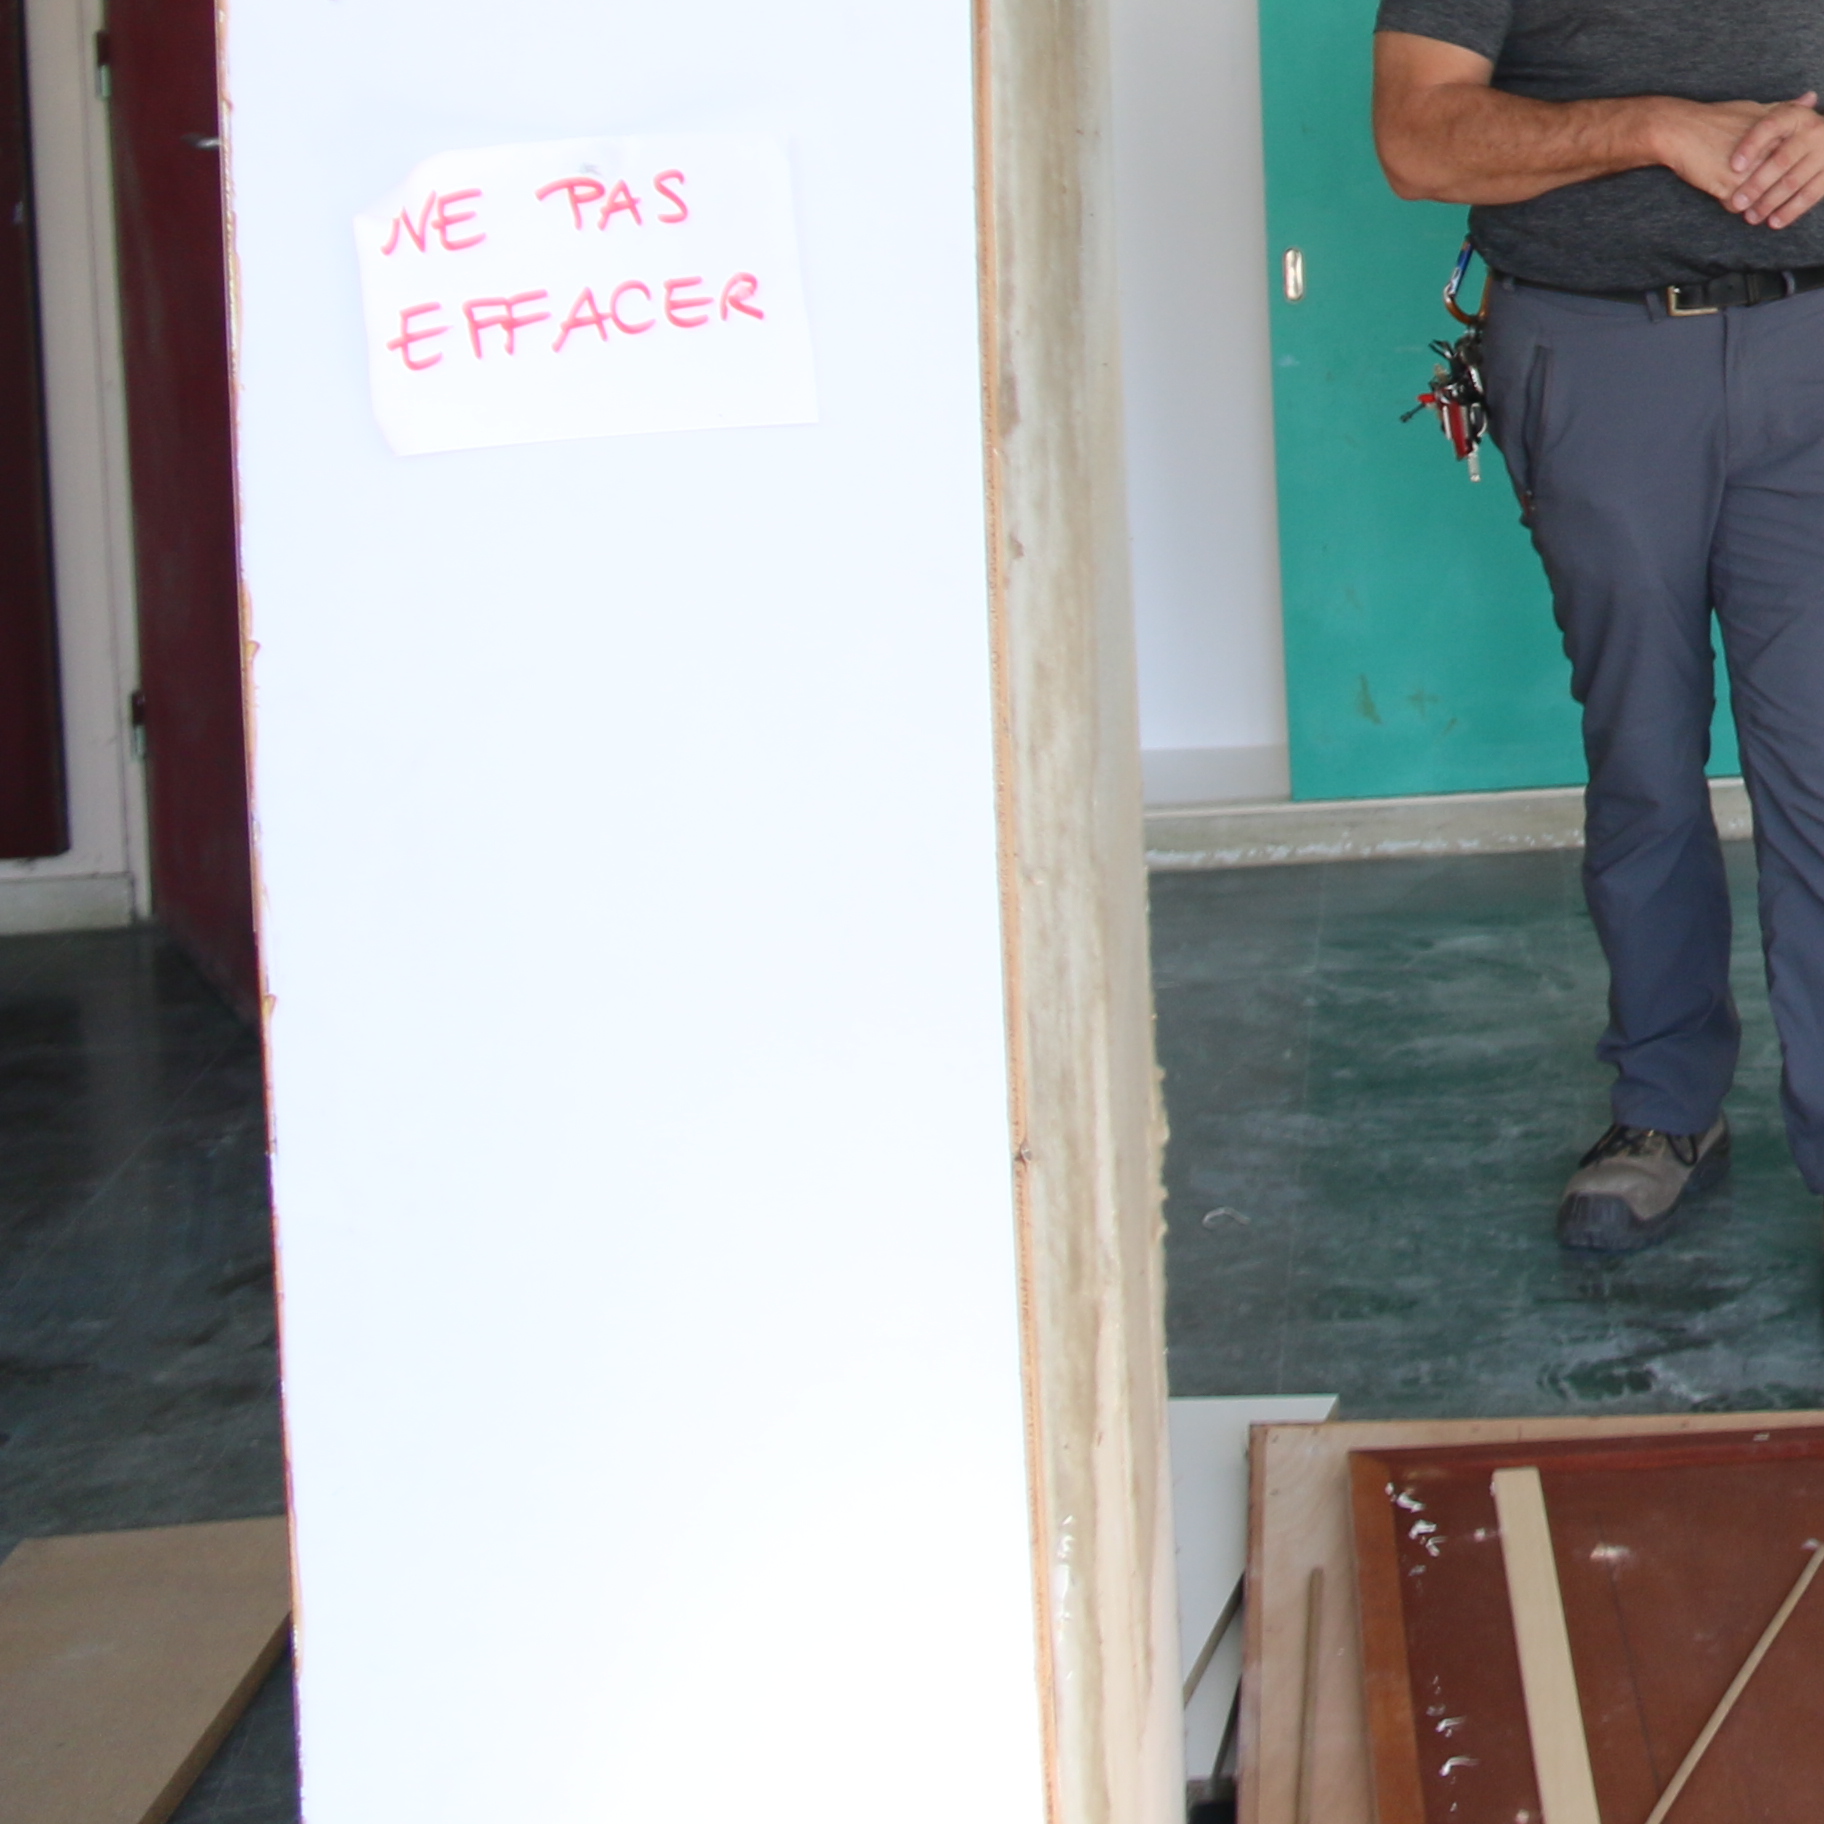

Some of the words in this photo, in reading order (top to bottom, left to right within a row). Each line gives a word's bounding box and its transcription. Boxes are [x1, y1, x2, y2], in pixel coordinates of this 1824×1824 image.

[380, 187, 487, 256] NE
[535, 168, 690, 231] PAS
[386, 271, 766, 372] EFFACER
